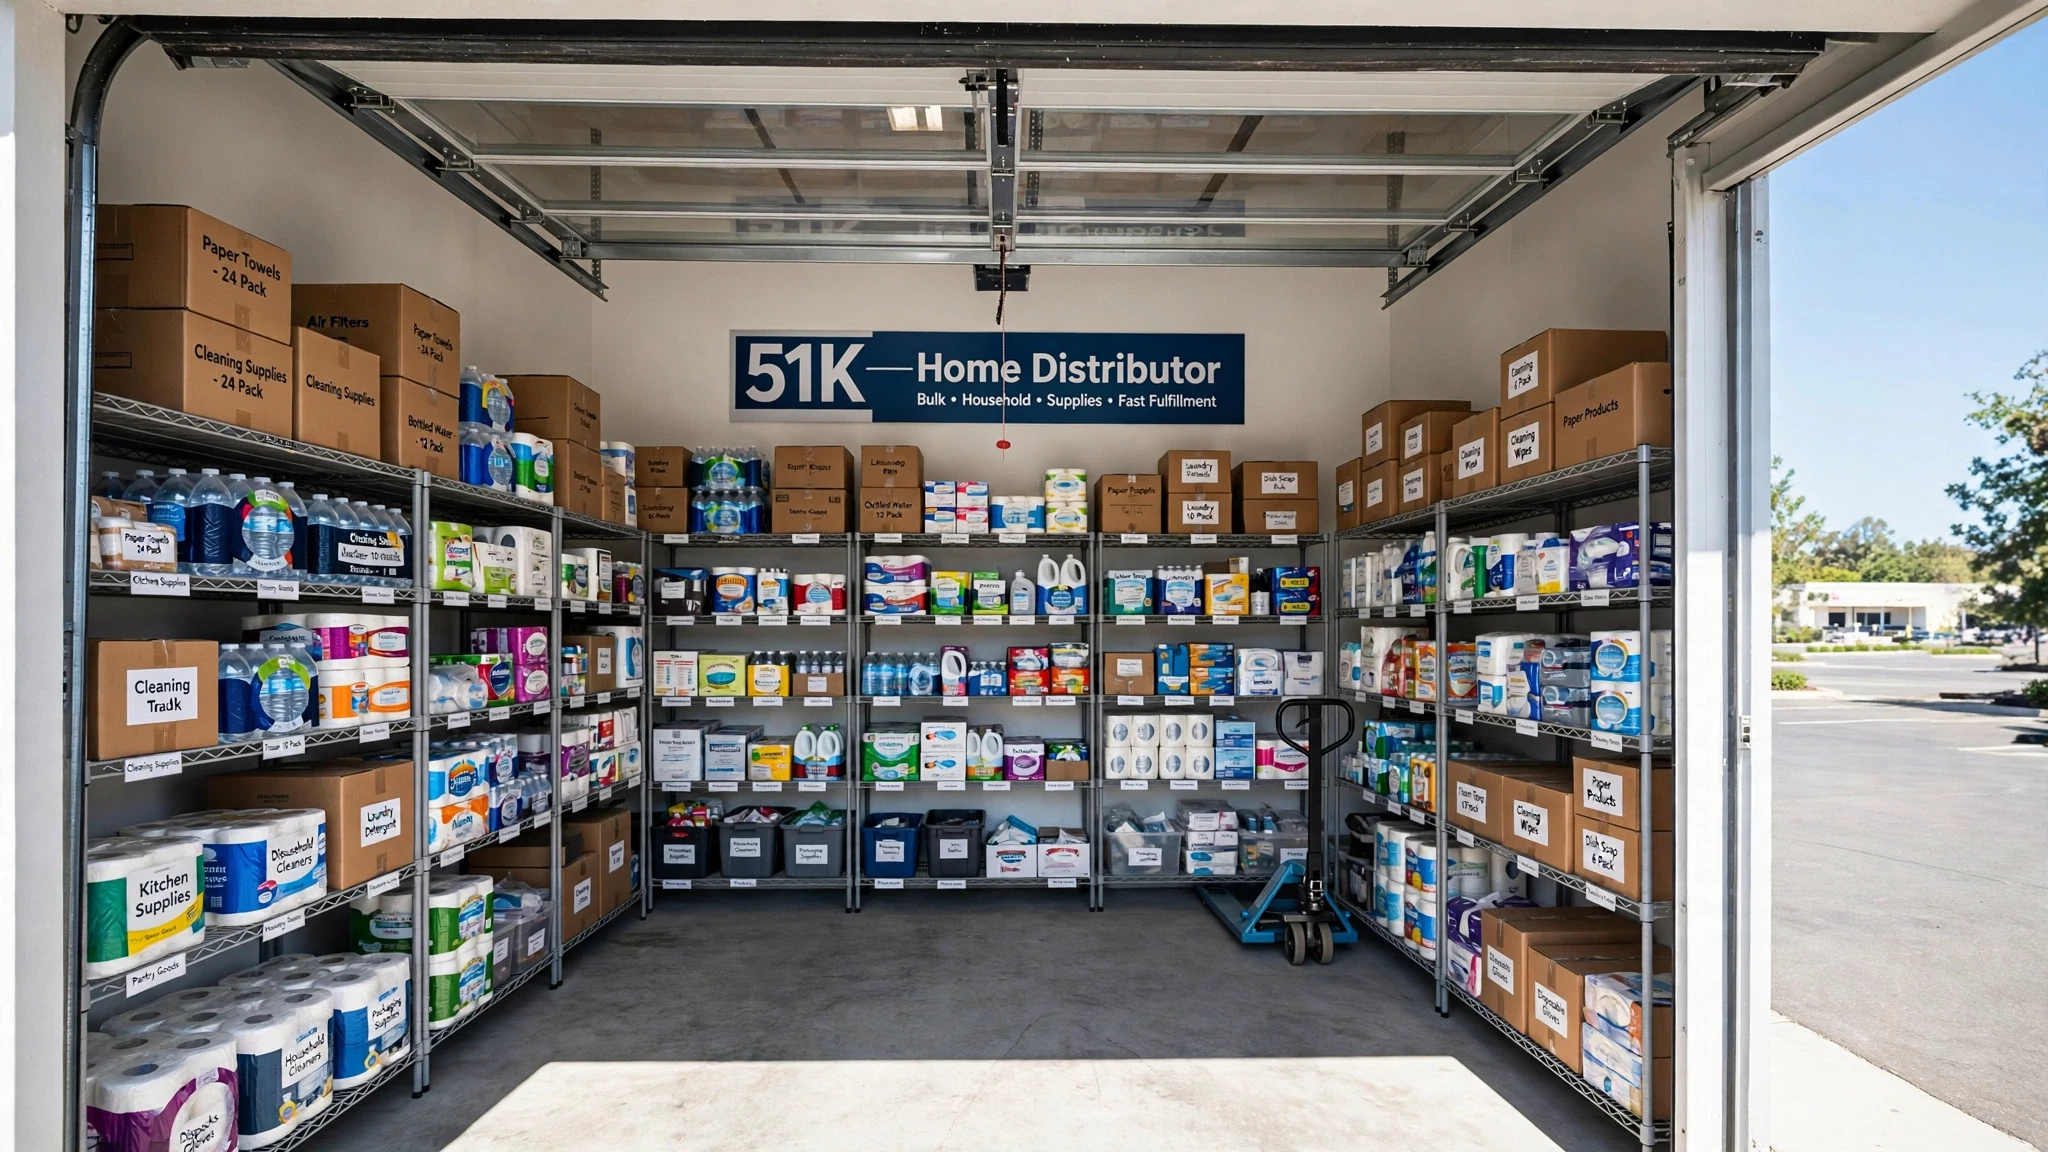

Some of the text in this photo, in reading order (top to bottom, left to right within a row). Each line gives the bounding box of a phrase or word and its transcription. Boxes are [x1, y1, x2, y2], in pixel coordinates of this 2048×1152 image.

[203, 235, 281, 281] Paper Towels
[222, 267, 237, 285] 24
[240, 274, 267, 298] Pack
[307, 315, 369, 329] Air Filters
[413, 323, 433, 342] Paper
[194, 344, 287, 384] Cleaning Supplies
[430, 350, 444, 363] Pack
[917, 352, 1221, 384] Home Distributor
[221, 374, 236, 391] 24
[238, 379, 264, 399] Pack
[745, 343, 866, 403] 51K
[306, 374, 375, 407] Cleaning Supplies
[917, 392, 1217, 410] Bulk Household Supplies Fast Fulfillment
[1563, 399, 1619, 429] Paper Products
[429, 440, 444, 453] Pack
[1514, 445, 1532, 461] Wipes
[134, 678, 191, 696] Cleaning
[139, 871, 189, 898] Kitchen
[135, 890, 191, 918] Supplies
